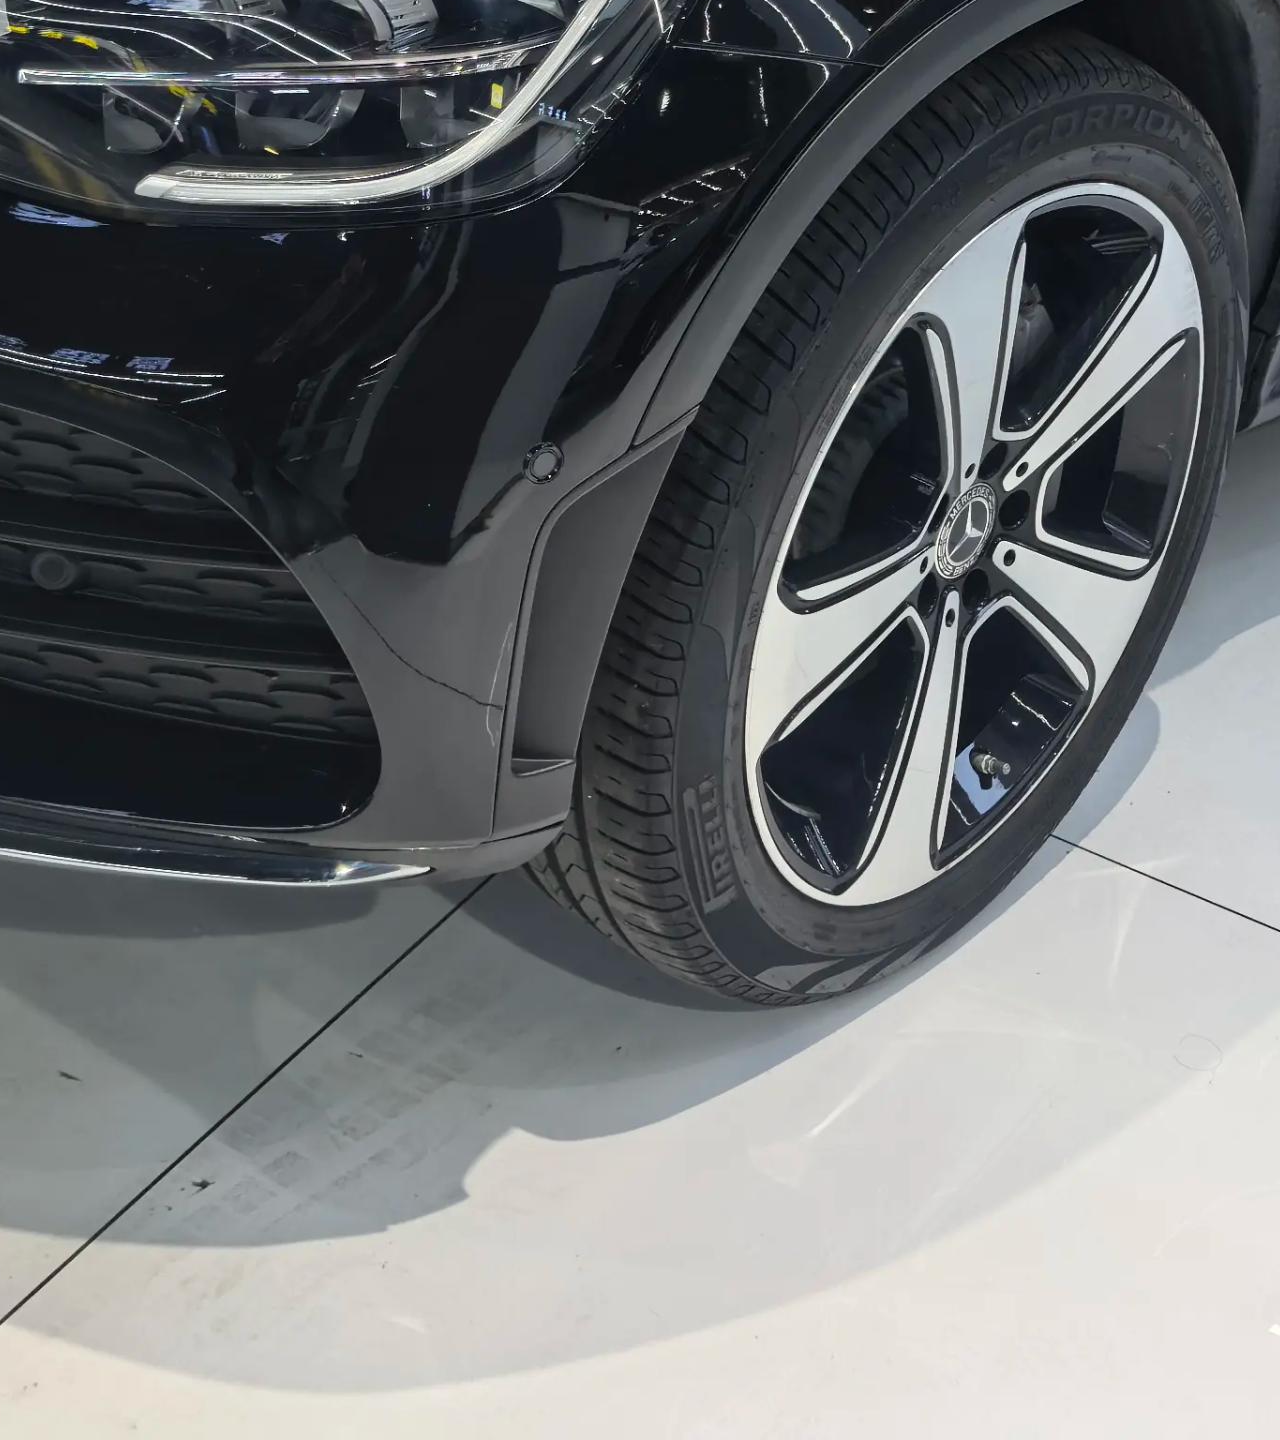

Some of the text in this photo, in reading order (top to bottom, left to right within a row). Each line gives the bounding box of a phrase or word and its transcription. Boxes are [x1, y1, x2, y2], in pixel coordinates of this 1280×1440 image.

[985, 103, 1192, 176] SCORPION
[949, 485, 990, 520] MERCEDES
[953, 556, 976, 576] BENZ
[682, 774, 737, 914] PIRELLI
